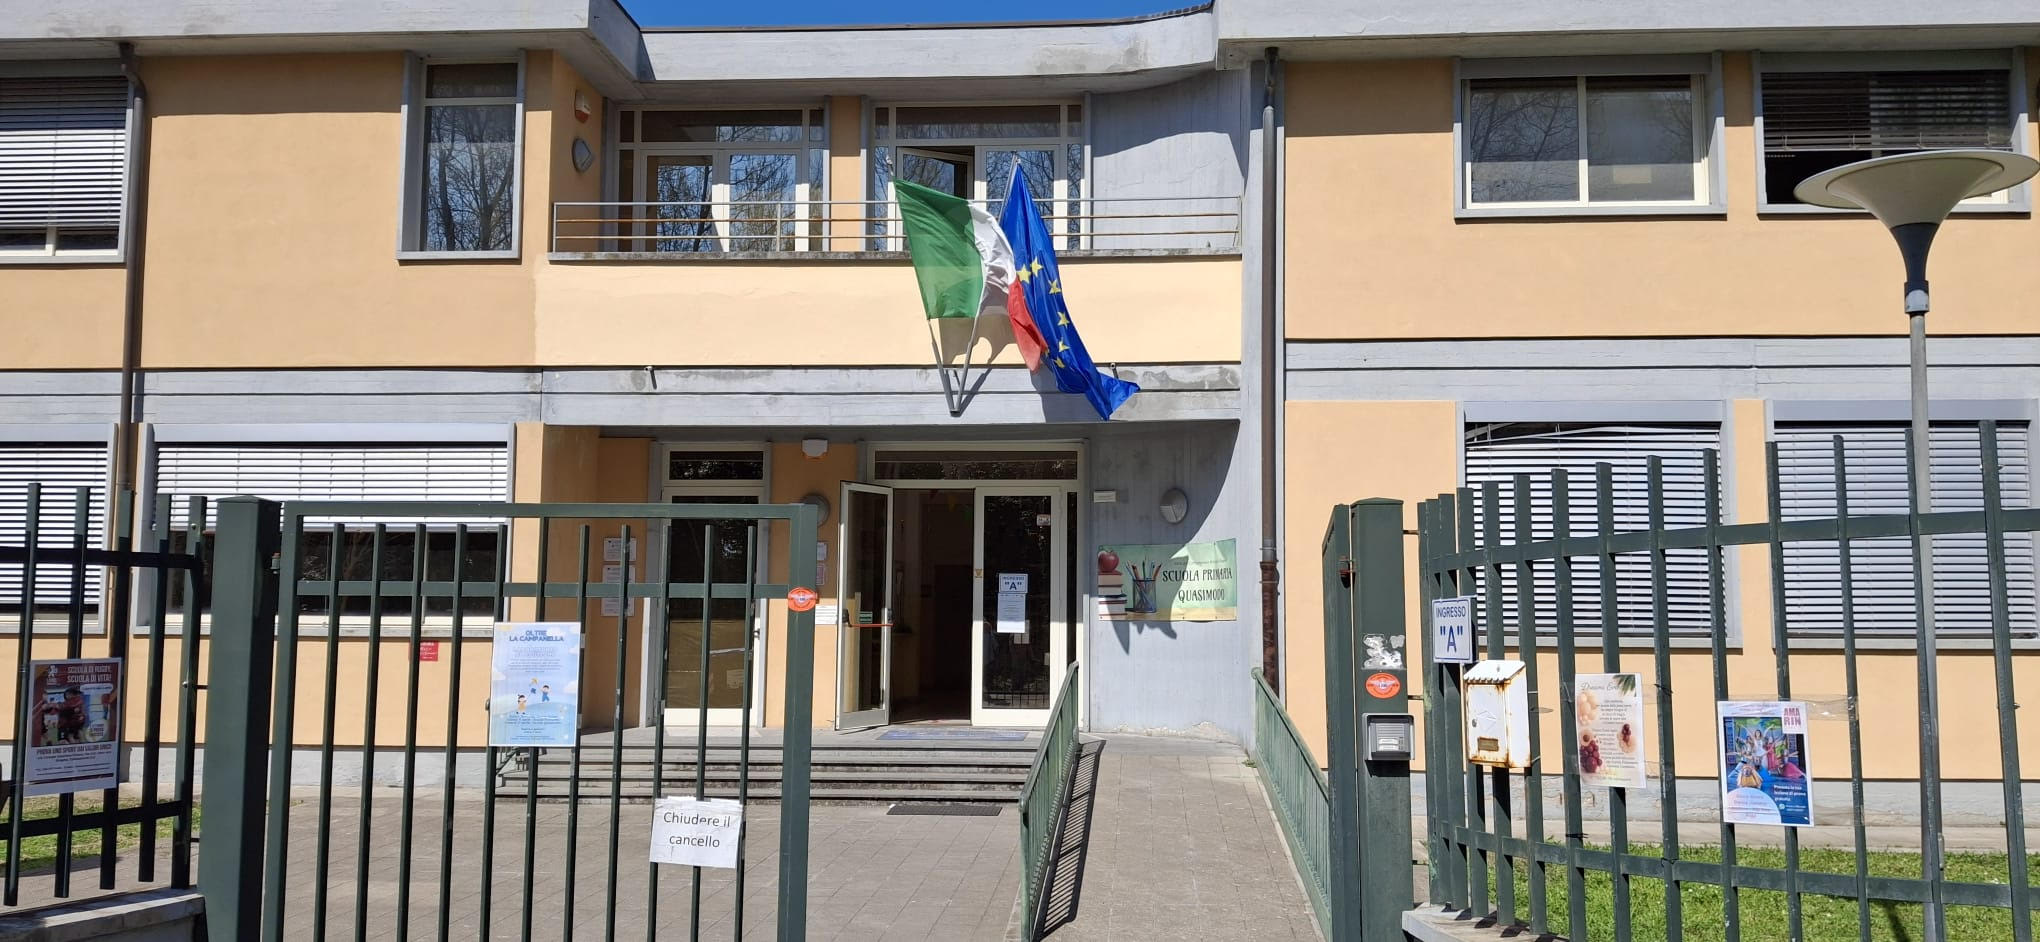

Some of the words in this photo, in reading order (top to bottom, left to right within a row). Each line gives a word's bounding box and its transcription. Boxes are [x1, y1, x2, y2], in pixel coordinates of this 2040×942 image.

[1162, 569, 1199, 582] SCUOLA
[1203, 567, 1233, 581] PRIMARIA
[1005, 581, 1022, 590] "A"
[1178, 588, 1225, 603] QUASIMODO
[1435, 605, 1466, 618] INGRESSO
[1439, 625, 1463, 653] "A"
[67, 666, 88, 674] SCUOLA
[66, 675, 90, 683] SCUOLA
[91, 674, 97, 682] DI
[1783, 707, 1801, 716] AMA
[1783, 715, 1802, 726] RIN
[663, 811, 720, 827] Chiudere
[723, 816, 731, 828] il
[669, 835, 720, 848] cancello
